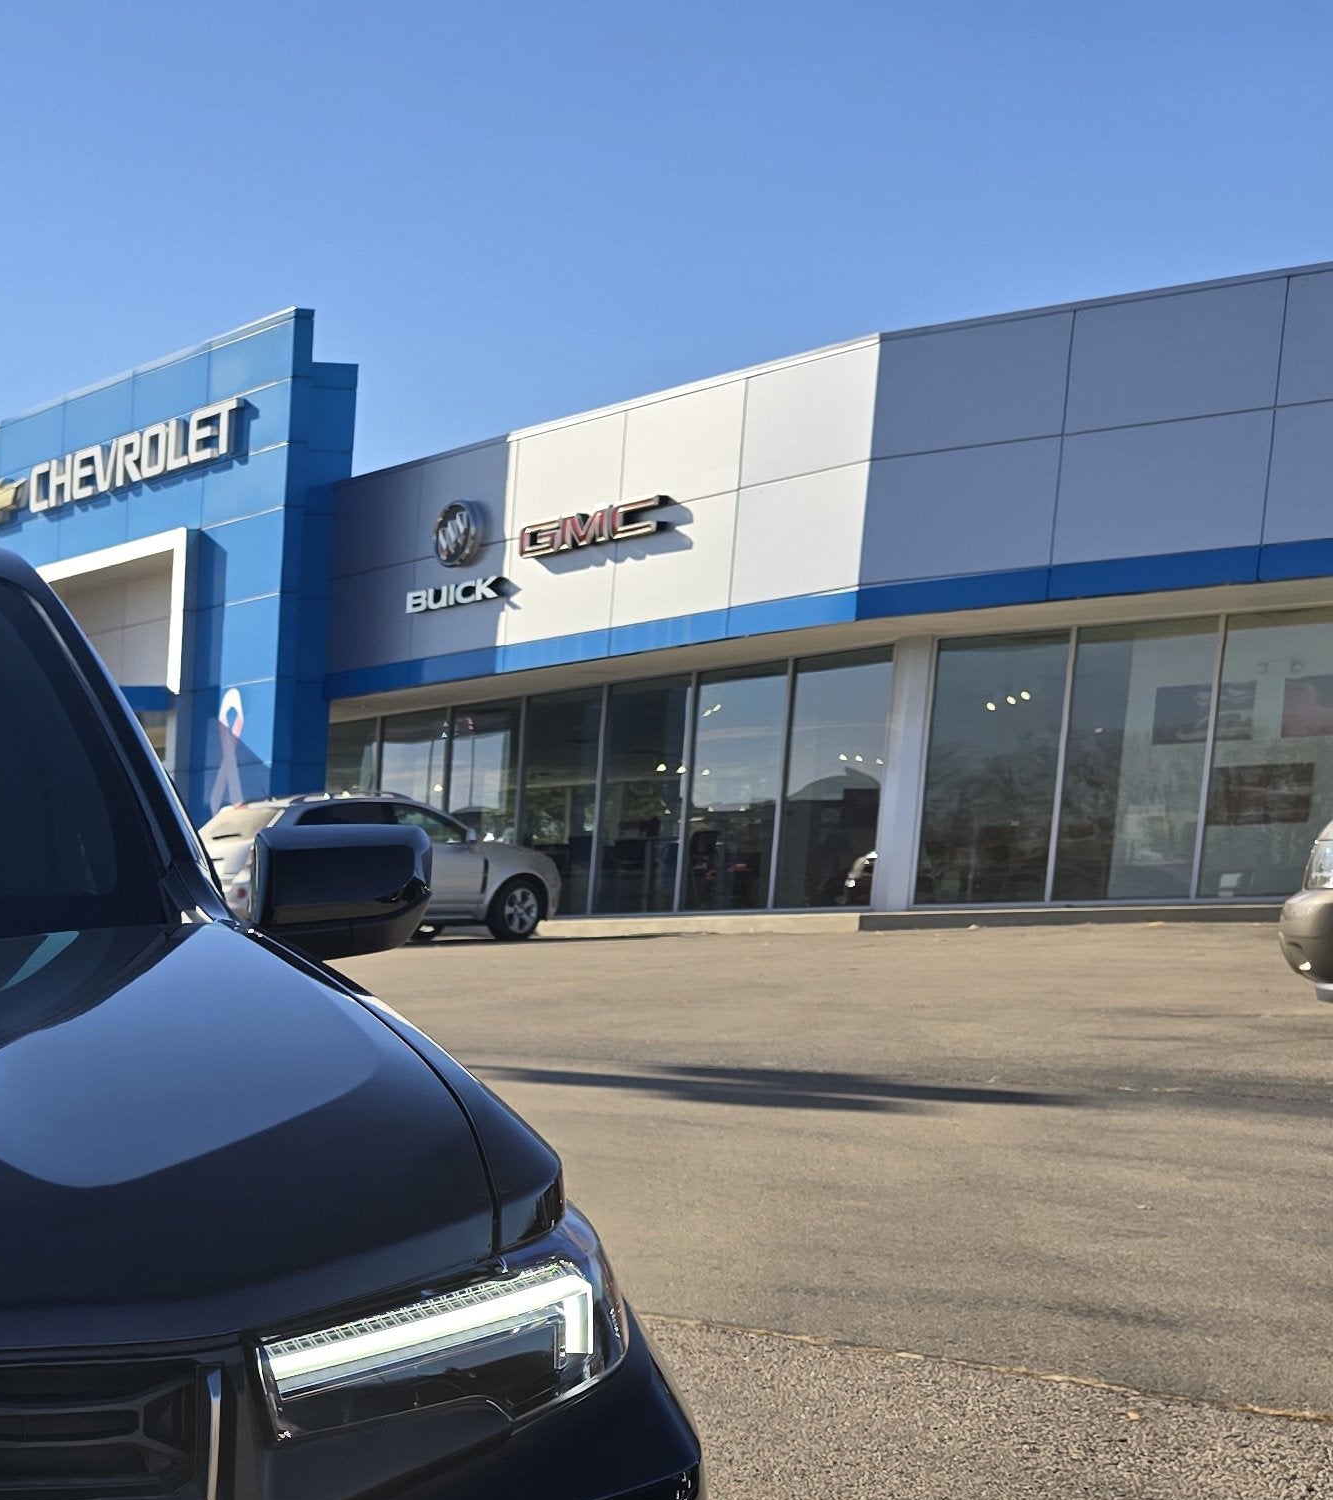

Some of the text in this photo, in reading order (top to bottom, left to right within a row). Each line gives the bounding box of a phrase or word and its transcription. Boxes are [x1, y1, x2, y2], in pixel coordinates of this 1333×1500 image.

[29, 398, 244, 513] CHEVROLET
[519, 495, 661, 559] GMC
[405, 576, 499, 613] BUICK
